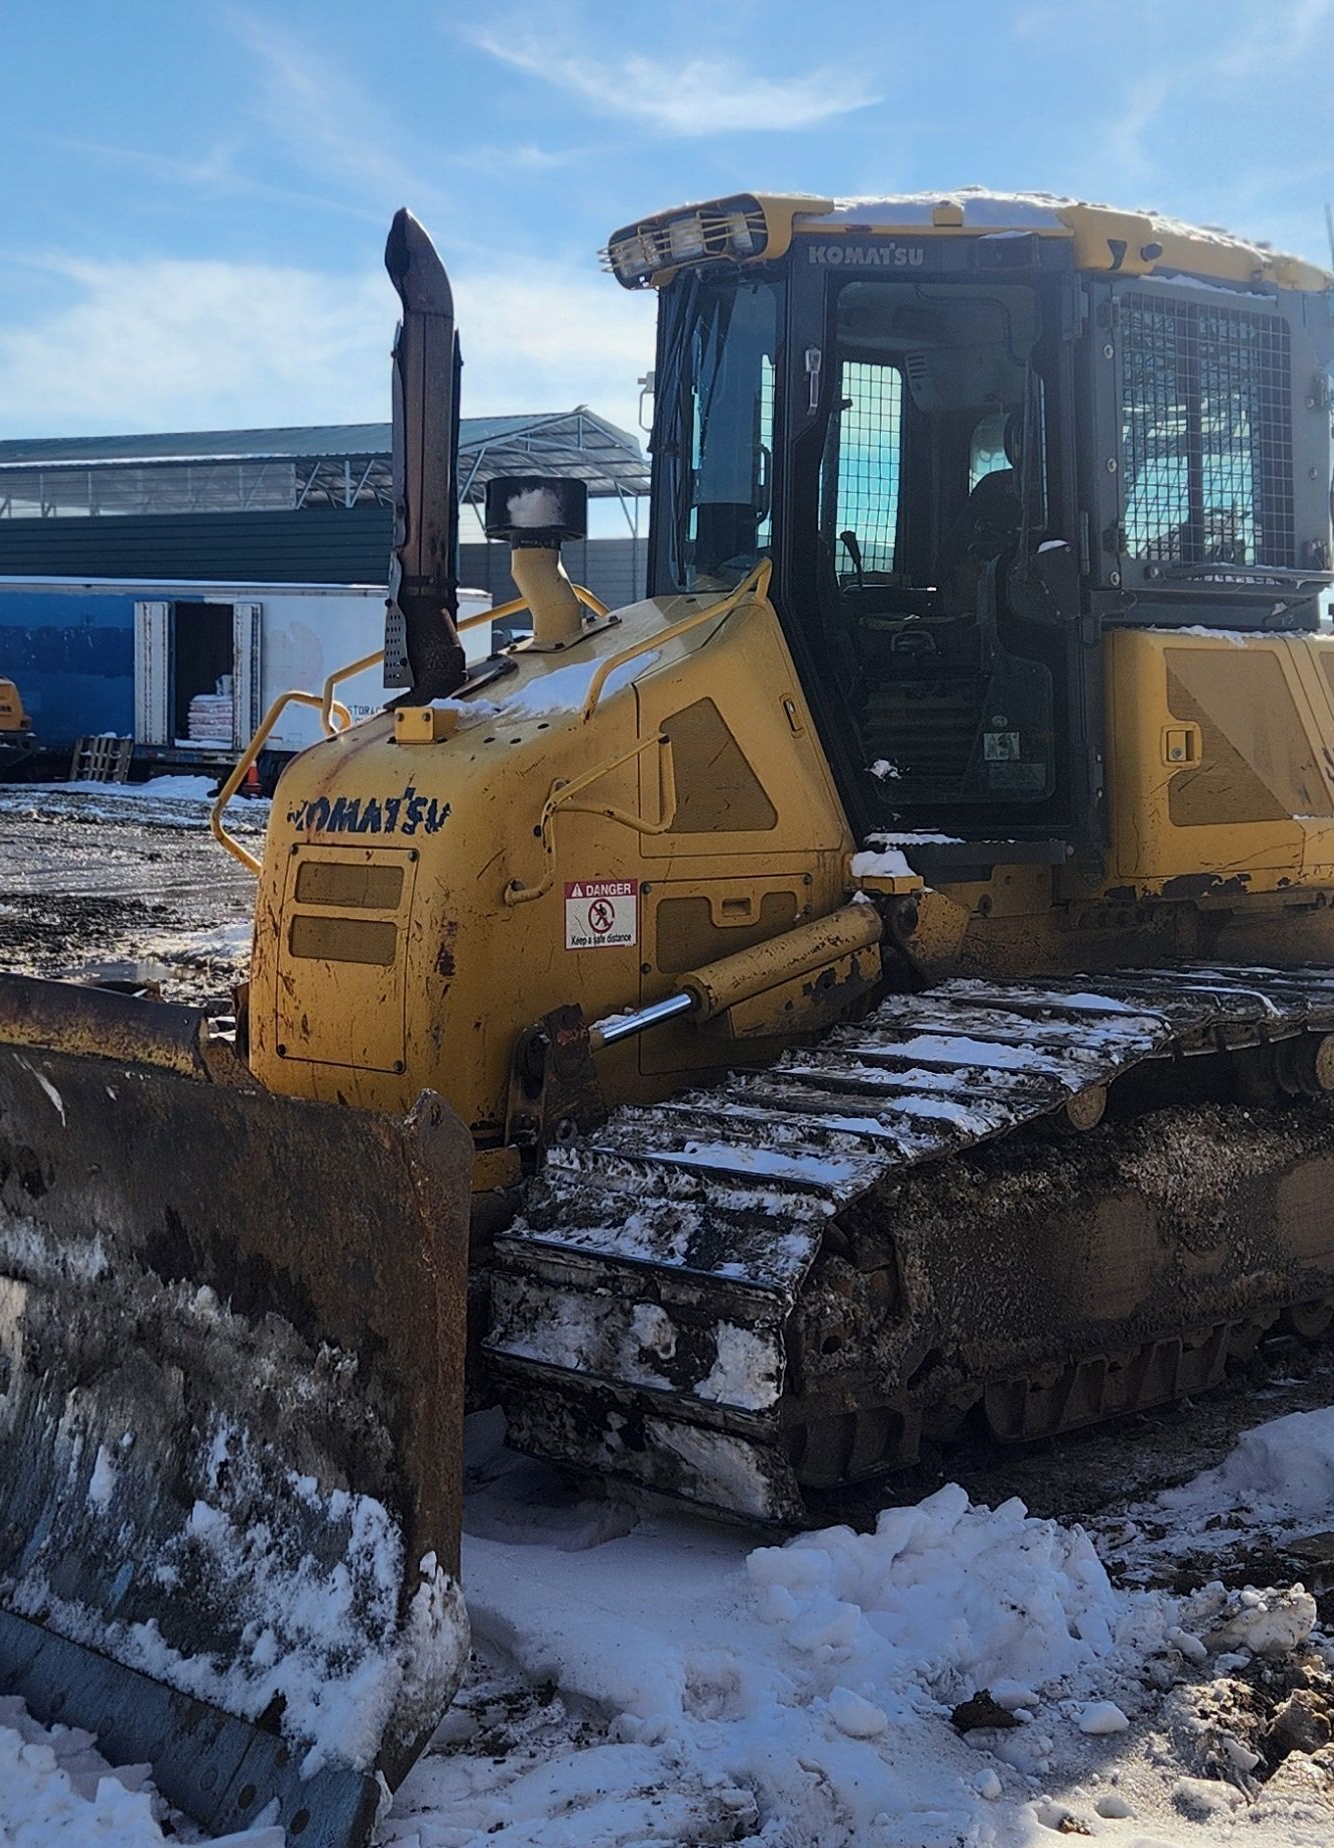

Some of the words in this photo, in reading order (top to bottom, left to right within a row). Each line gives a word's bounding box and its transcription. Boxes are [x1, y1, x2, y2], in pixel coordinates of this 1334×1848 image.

[809, 242, 923, 266] KOMATSU
[347, 704, 382, 715] STORAG
[586, 883, 631, 897] DANGER
[571, 935, 587, 946] Keep
[594, 934, 605, 944] safe
[607, 933, 631, 943] distance
